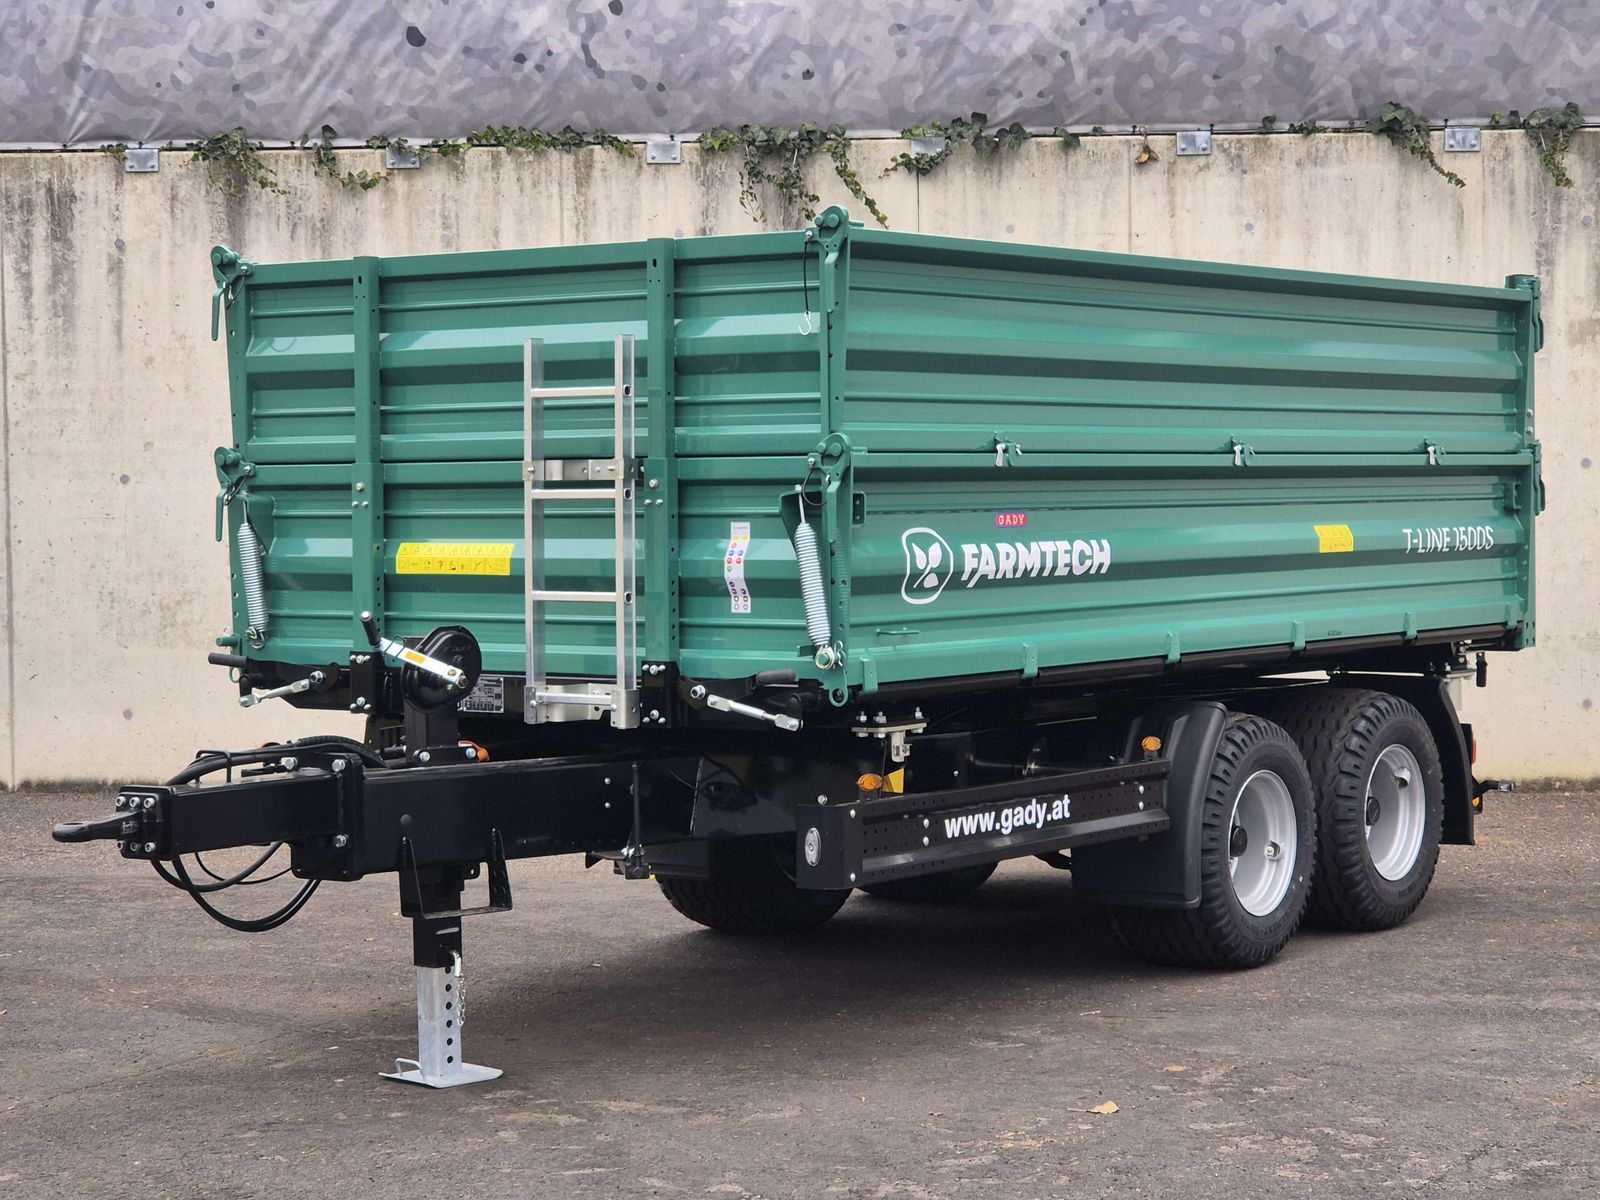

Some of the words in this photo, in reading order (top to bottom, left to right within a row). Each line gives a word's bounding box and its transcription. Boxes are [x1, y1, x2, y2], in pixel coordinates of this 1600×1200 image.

[997, 513, 1025, 526] GADY
[1402, 527, 1451, 554] T-LINE
[1453, 525, 1494, 551] 1500S
[961, 539, 1111, 588] FARMTECH
[944, 794, 1070, 838] www.gady.at
